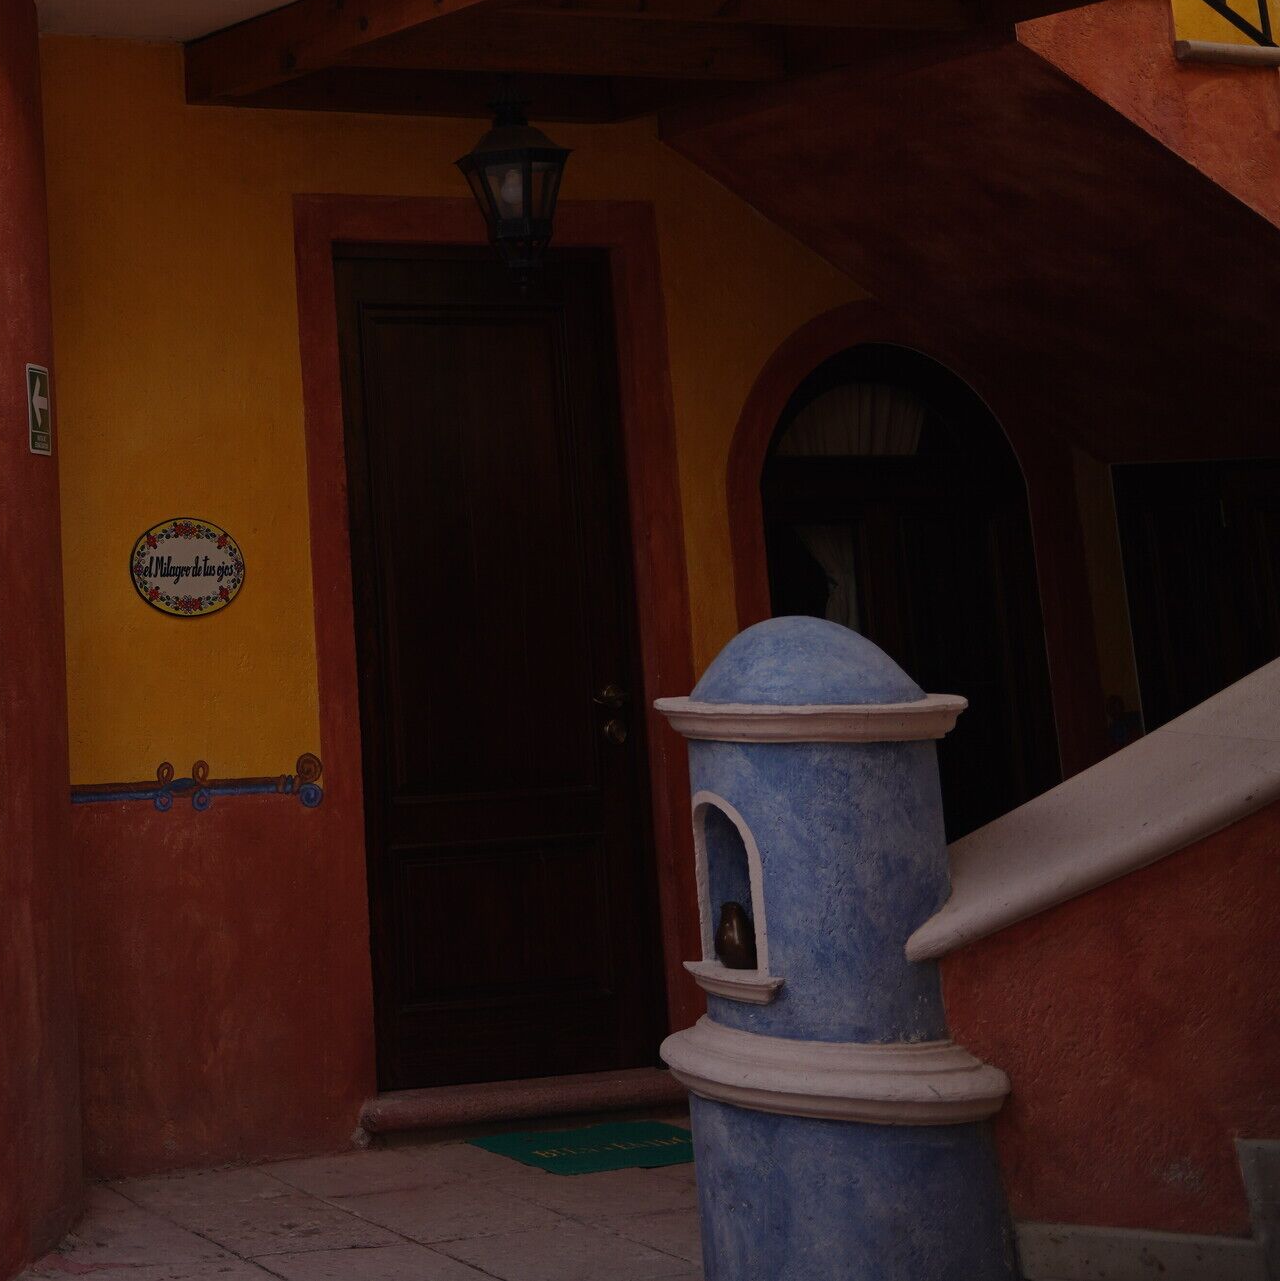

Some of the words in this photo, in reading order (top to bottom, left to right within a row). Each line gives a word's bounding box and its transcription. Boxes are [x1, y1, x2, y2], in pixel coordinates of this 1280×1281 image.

[143, 556, 154, 578] el
[153, 555, 190, 585] Milagro
[191, 555, 203, 577] de
[203, 555, 216, 577] tus
[216, 561, 234, 583] ojos
